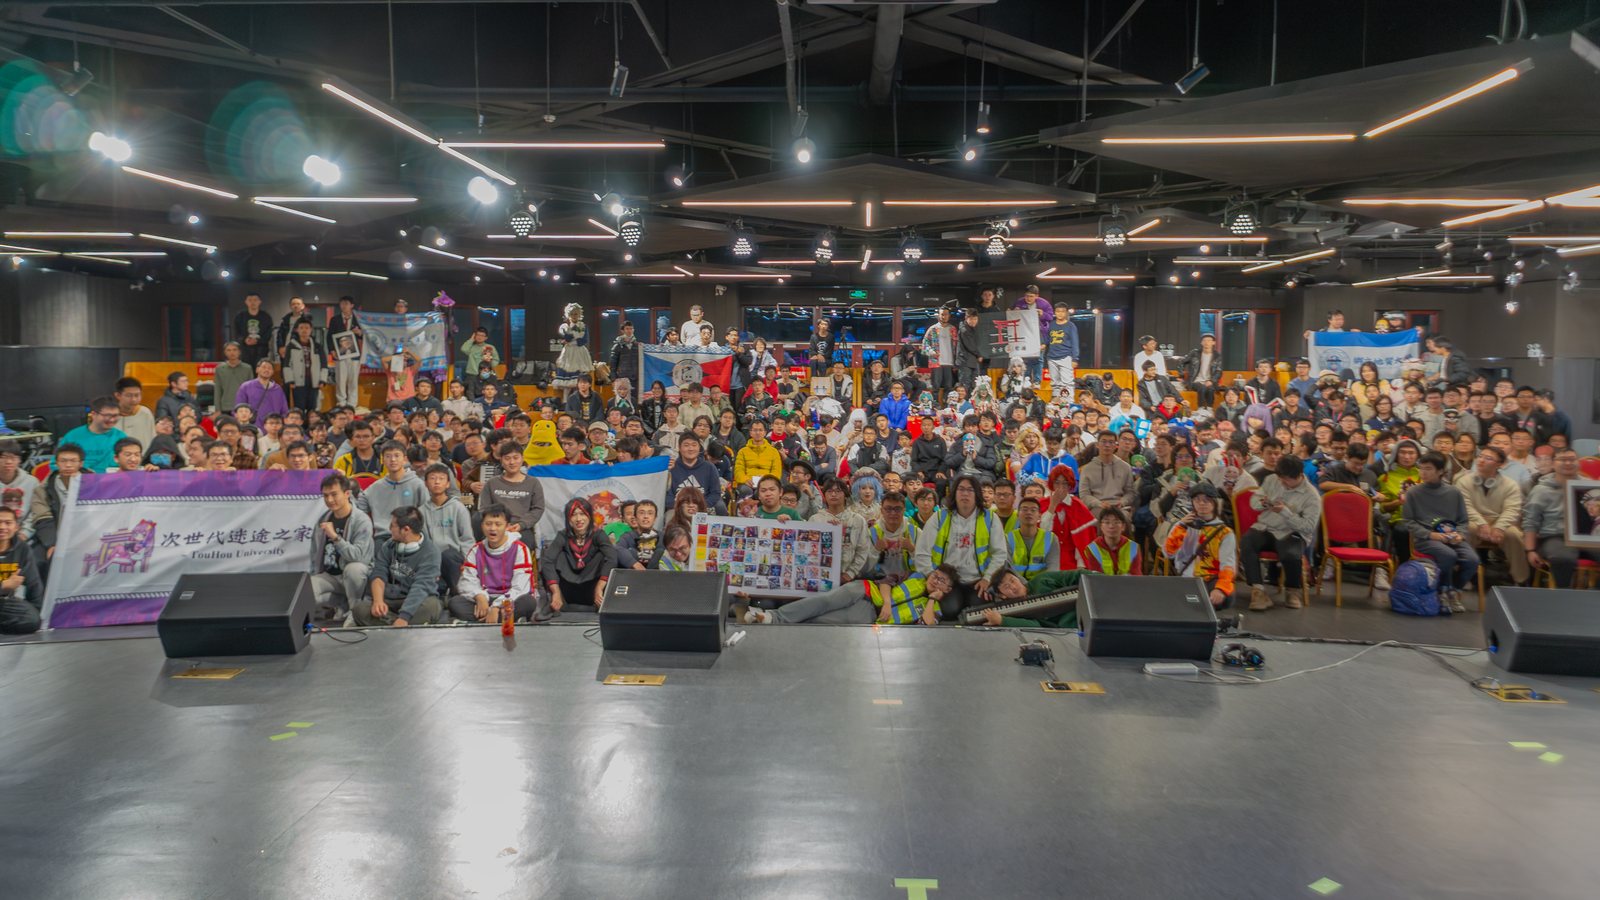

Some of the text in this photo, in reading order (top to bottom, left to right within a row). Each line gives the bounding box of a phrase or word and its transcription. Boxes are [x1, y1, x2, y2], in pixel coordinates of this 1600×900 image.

[161, 525, 313, 546] 次世代迷途之家
[236, 548, 285, 558] University
